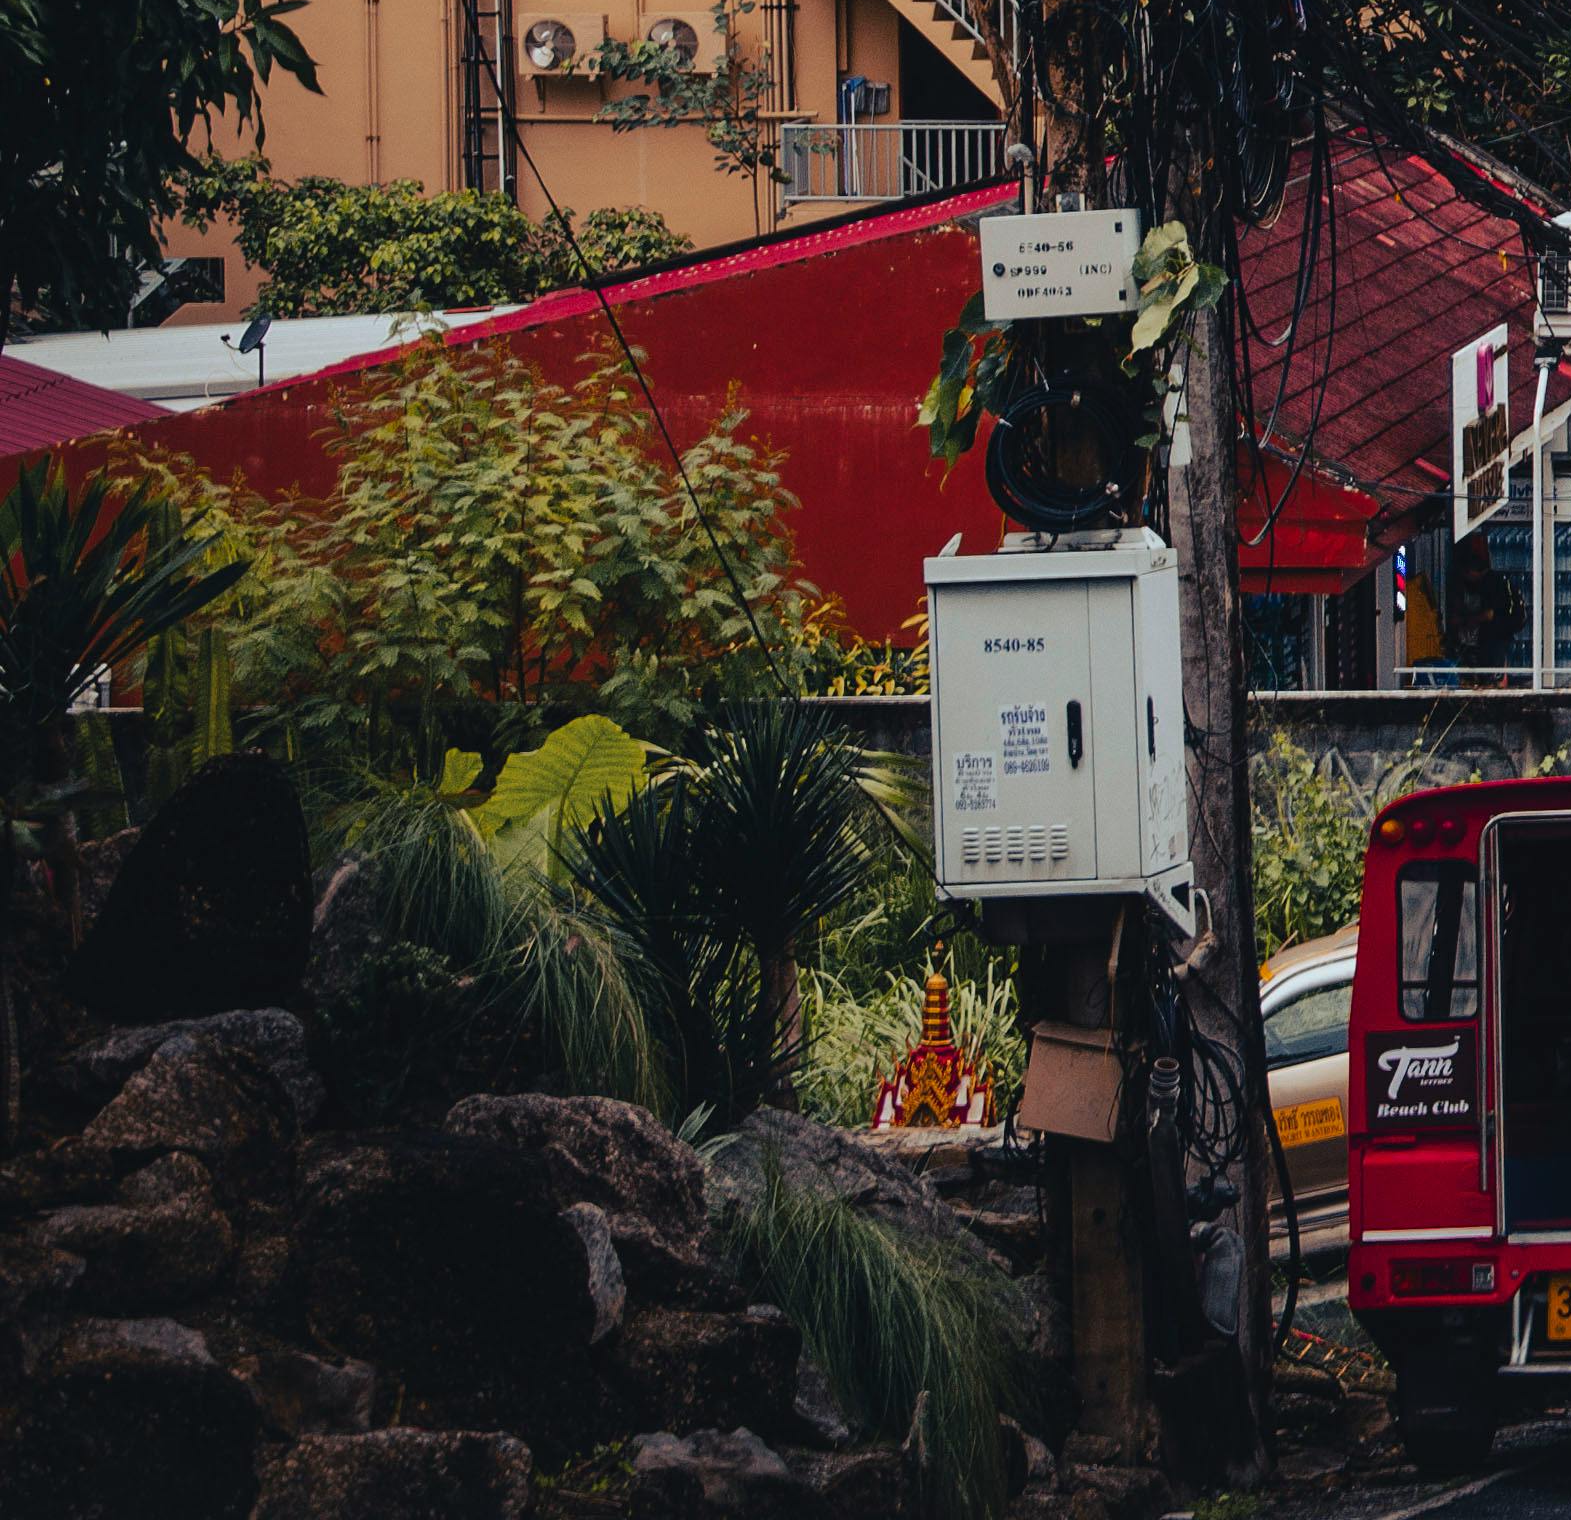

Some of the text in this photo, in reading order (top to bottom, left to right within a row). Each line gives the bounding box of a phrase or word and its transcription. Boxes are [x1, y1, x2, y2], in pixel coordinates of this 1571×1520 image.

[1079, 262, 1112, 275] (INC)
[984, 637, 1045, 653] 8540-85
[957, 754, 992, 770] บริการ
[1378, 1041, 1459, 1099] Tann
[1377, 1099, 1469, 1118] Beach Club
